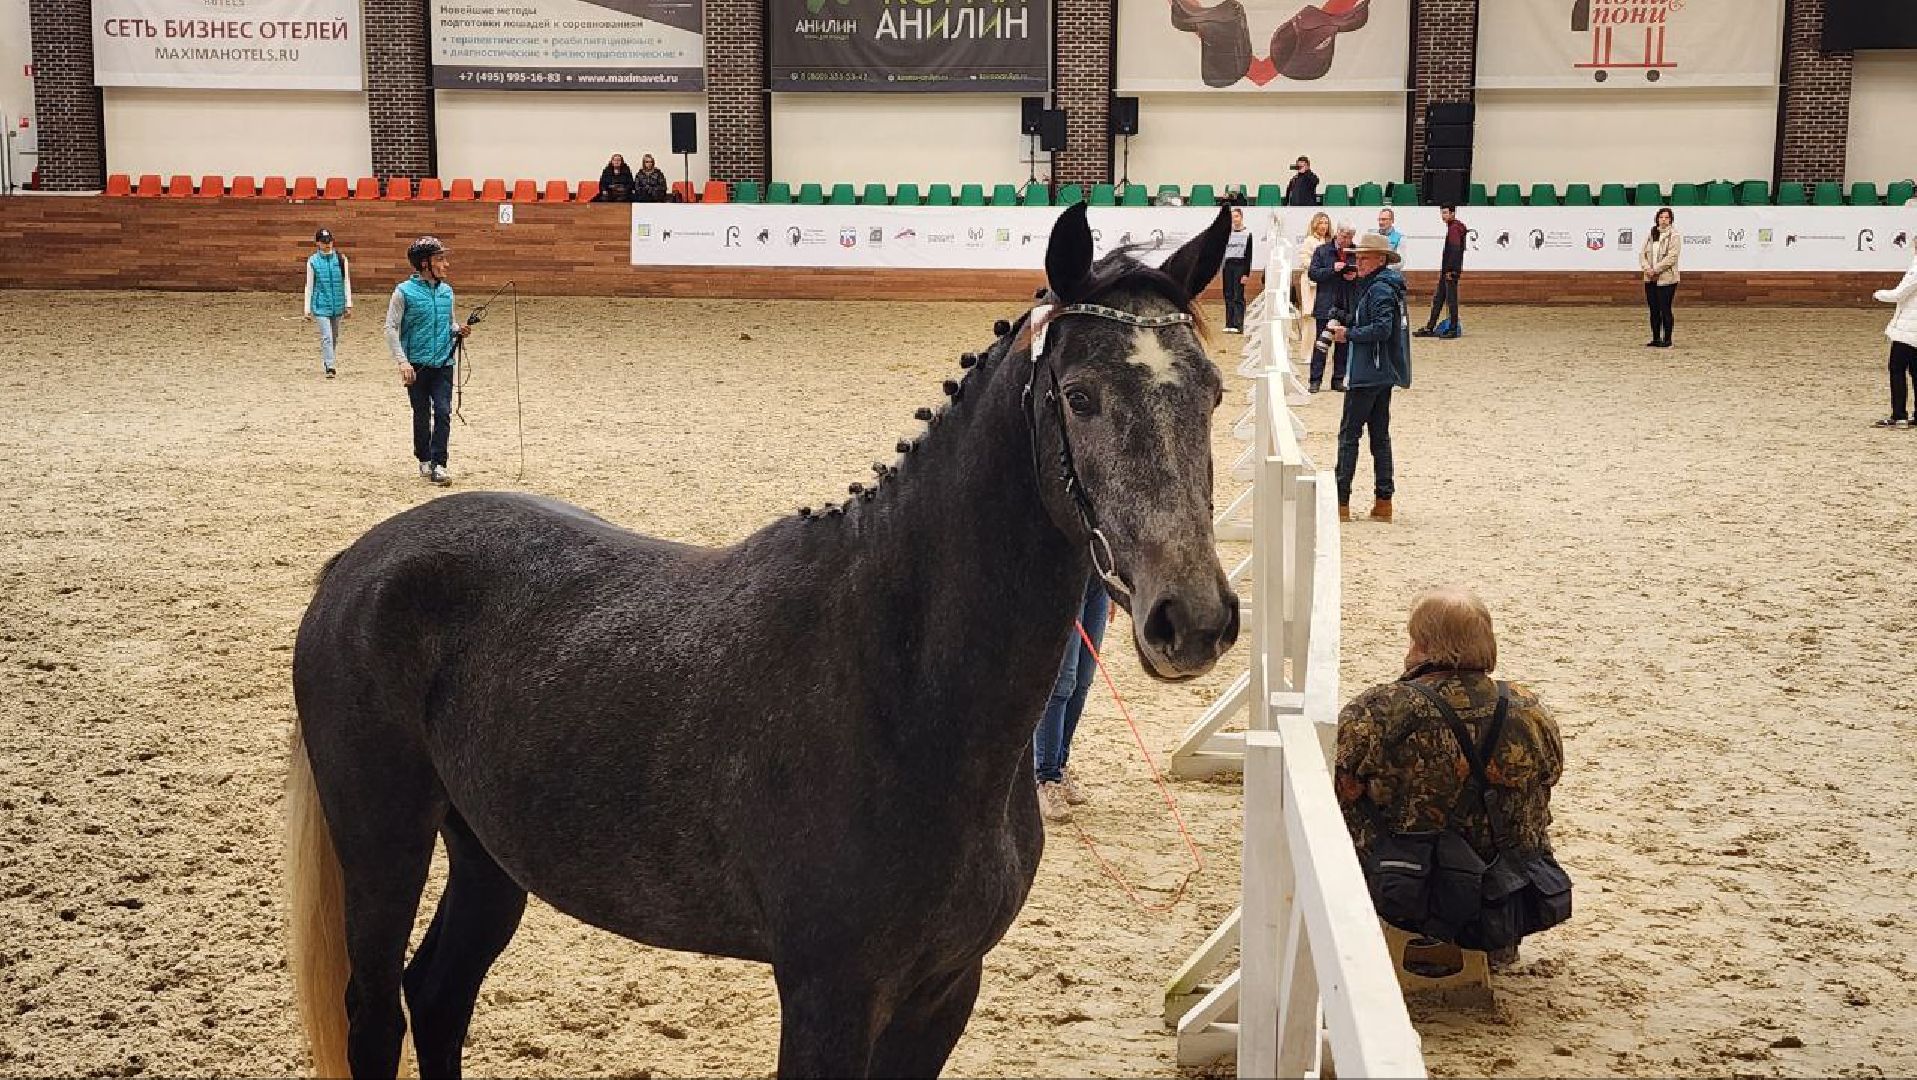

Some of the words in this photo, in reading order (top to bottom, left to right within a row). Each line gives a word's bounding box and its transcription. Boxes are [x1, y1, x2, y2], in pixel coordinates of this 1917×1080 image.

[440, 5, 495, 15] Новейшие
[497, 8, 537, 16] методы
[1593, 8, 1667, 23] пони
[104, 19, 157, 38] СЕТЬ
[165, 20, 253, 39] БИЗНЕС
[259, 17, 349, 40] ОТЕЛЕЙ
[440, 20, 500, 28] подготовки
[503, 19, 550, 29] лошадей
[562, 21, 643, 29] соревнованиям
[795, 19, 857, 33] АНИЛИН
[875, 7, 1028, 39] АНИЛИН
[155, 47, 299, 61] MAXIMAHOTELS.RU
[458, 73, 473, 81] +7
[476, 73, 504, 83] (495)
[506, 73, 561, 82] 995-16-83
[578, 73, 678, 83] www.maximavet.ru
[501, 208, 511, 221] 6
